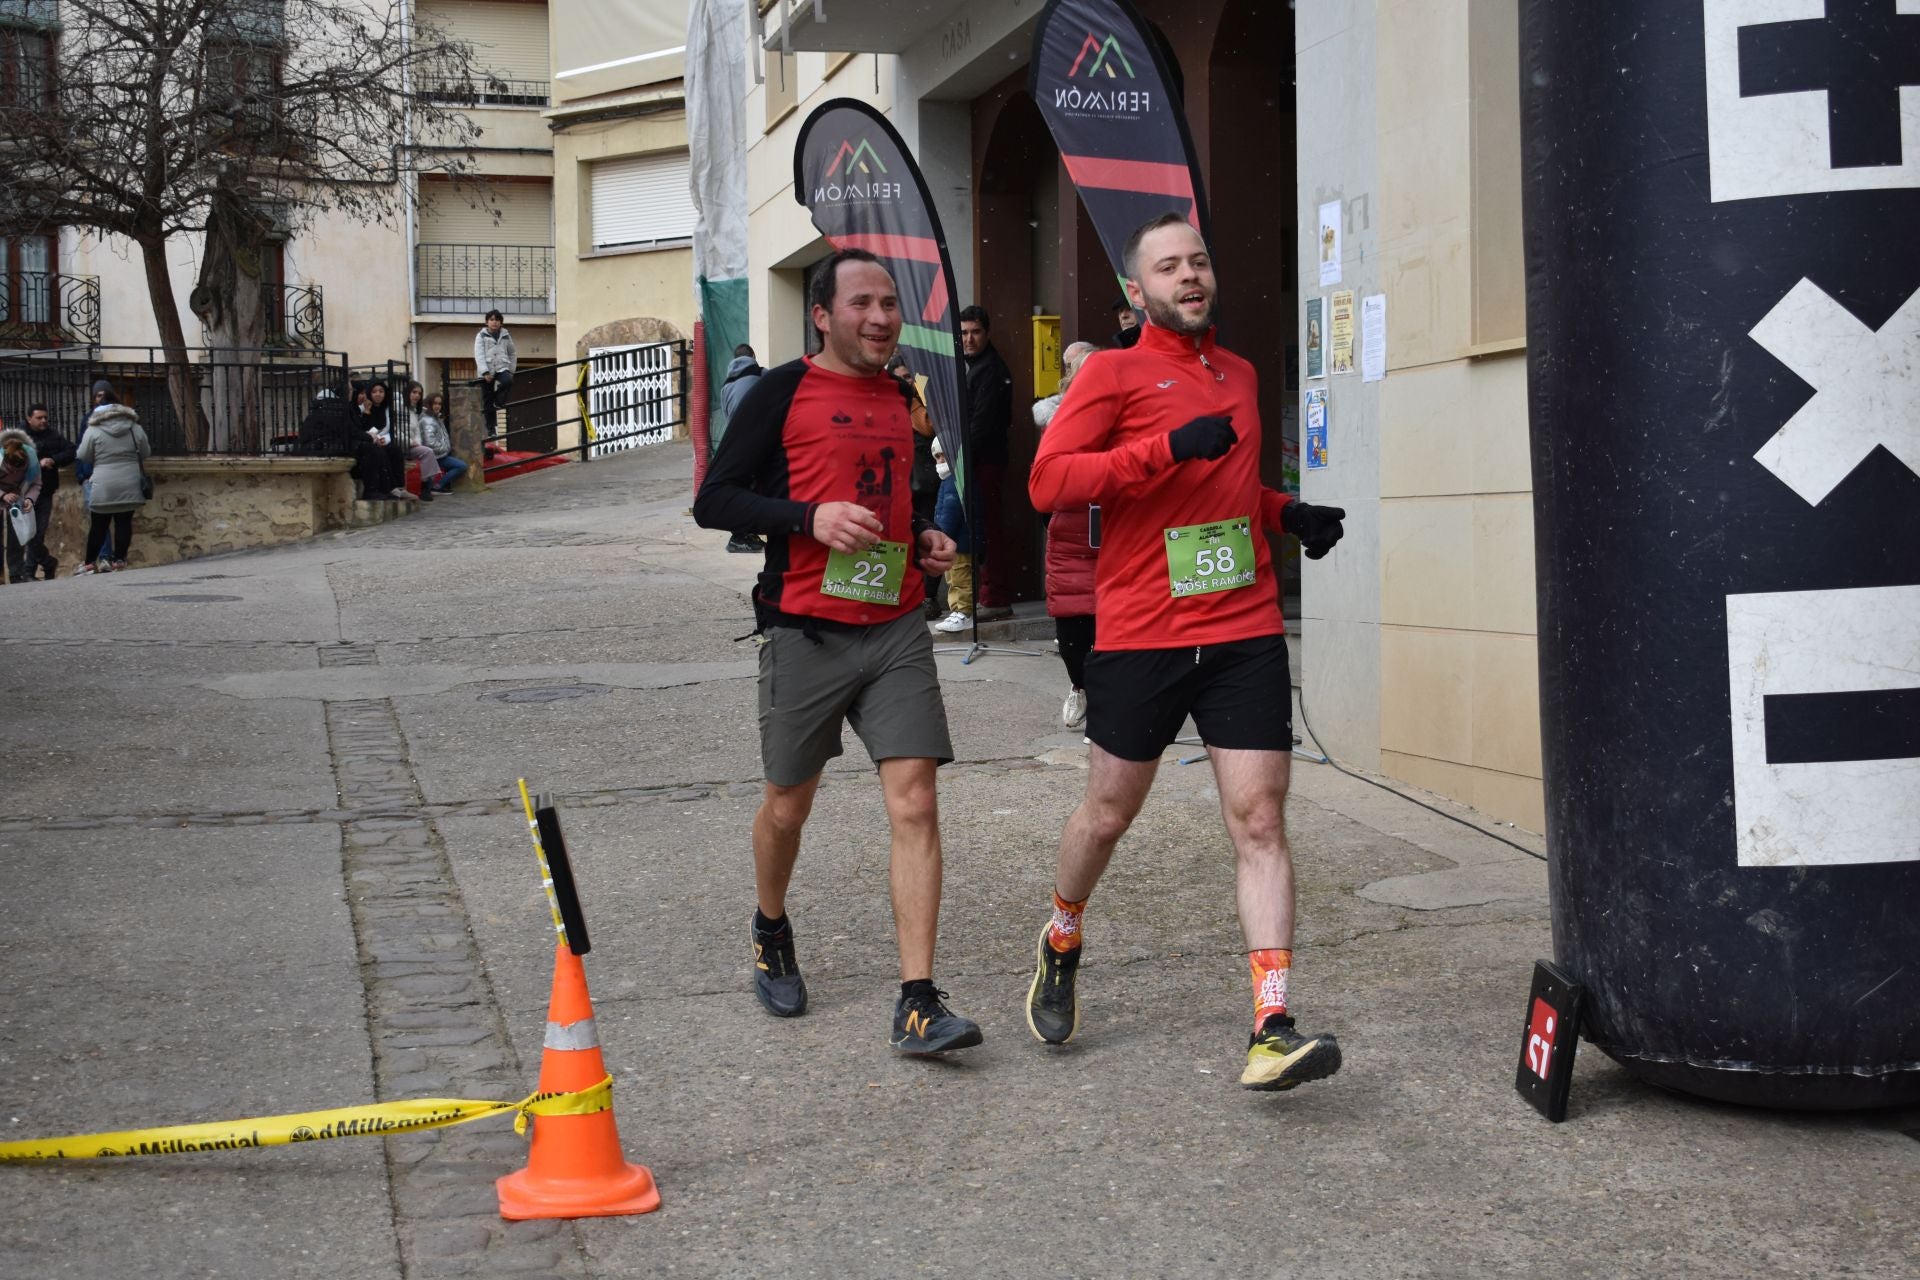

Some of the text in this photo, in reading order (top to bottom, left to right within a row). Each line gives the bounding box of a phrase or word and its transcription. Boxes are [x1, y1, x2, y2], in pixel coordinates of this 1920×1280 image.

[942, 17, 971, 60] CASA
[851, 560, 887, 587] 22
[1195, 546, 1235, 576] 58
[832, 584, 893, 600] JUAN PABLO
